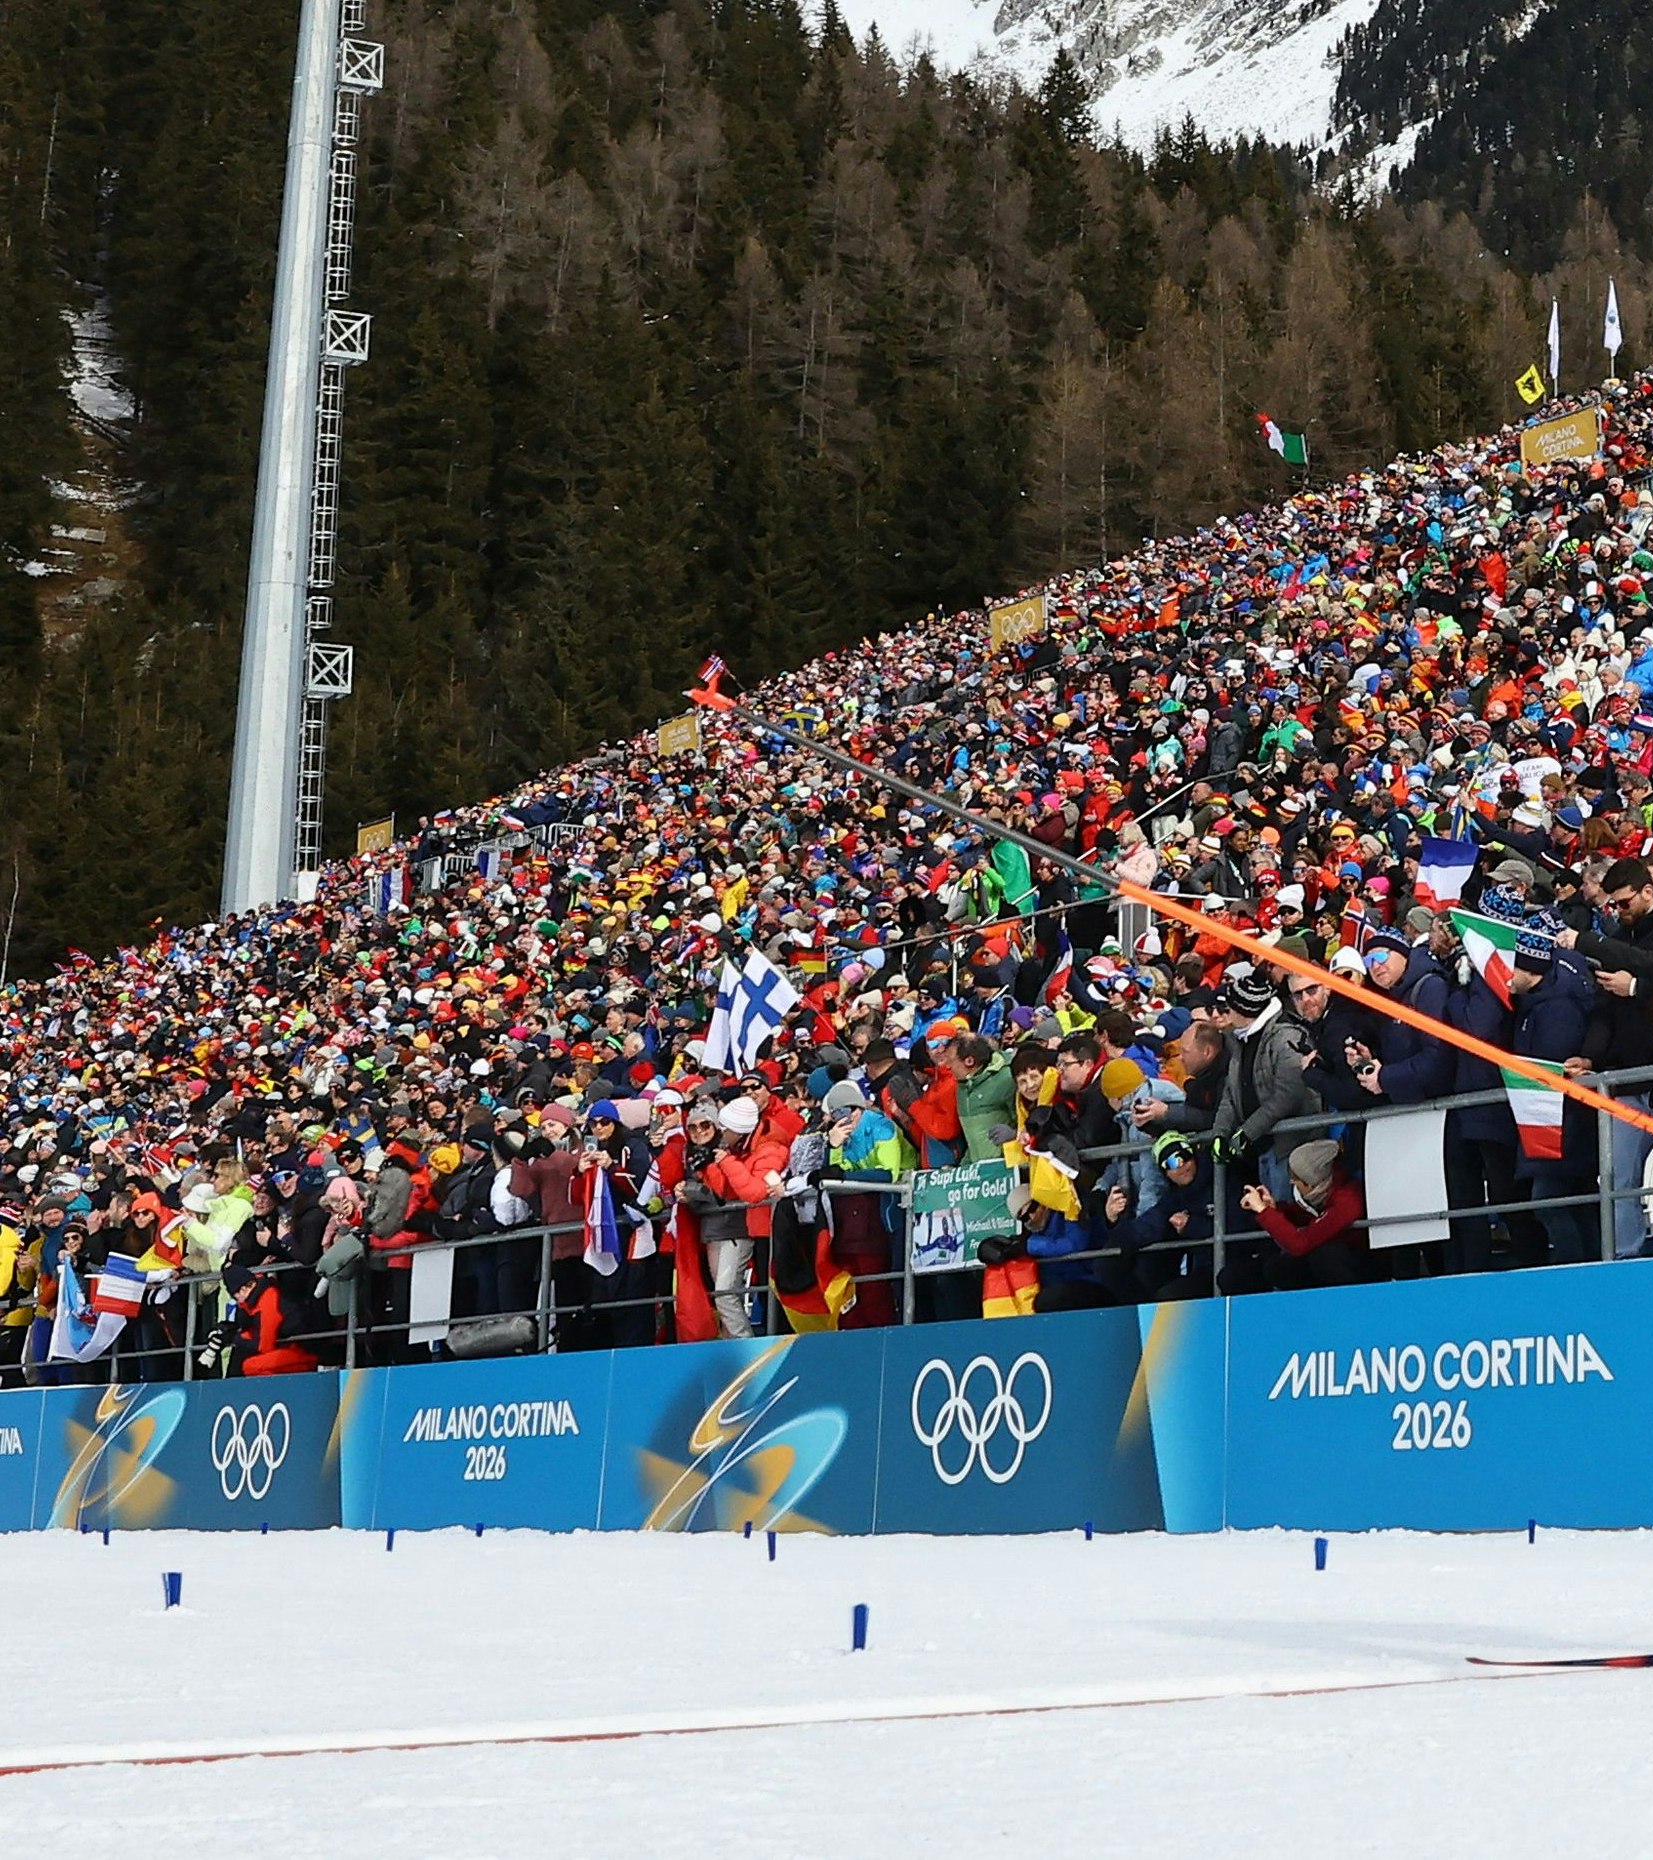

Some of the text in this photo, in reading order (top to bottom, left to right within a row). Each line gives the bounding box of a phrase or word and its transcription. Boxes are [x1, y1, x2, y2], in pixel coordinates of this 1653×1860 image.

[1535, 423, 1576, 449] MILANO
[948, 1190, 960, 1206] go
[963, 1184, 980, 1199] for
[982, 1178, 1007, 1197] Gold
[1269, 1334, 1613, 1398] MILANO CORTINA
[404, 1401, 578, 1441] MILANO CORTINA
[1393, 1402, 1470, 1449] 2026
[464, 1446, 505, 1479] 2026
